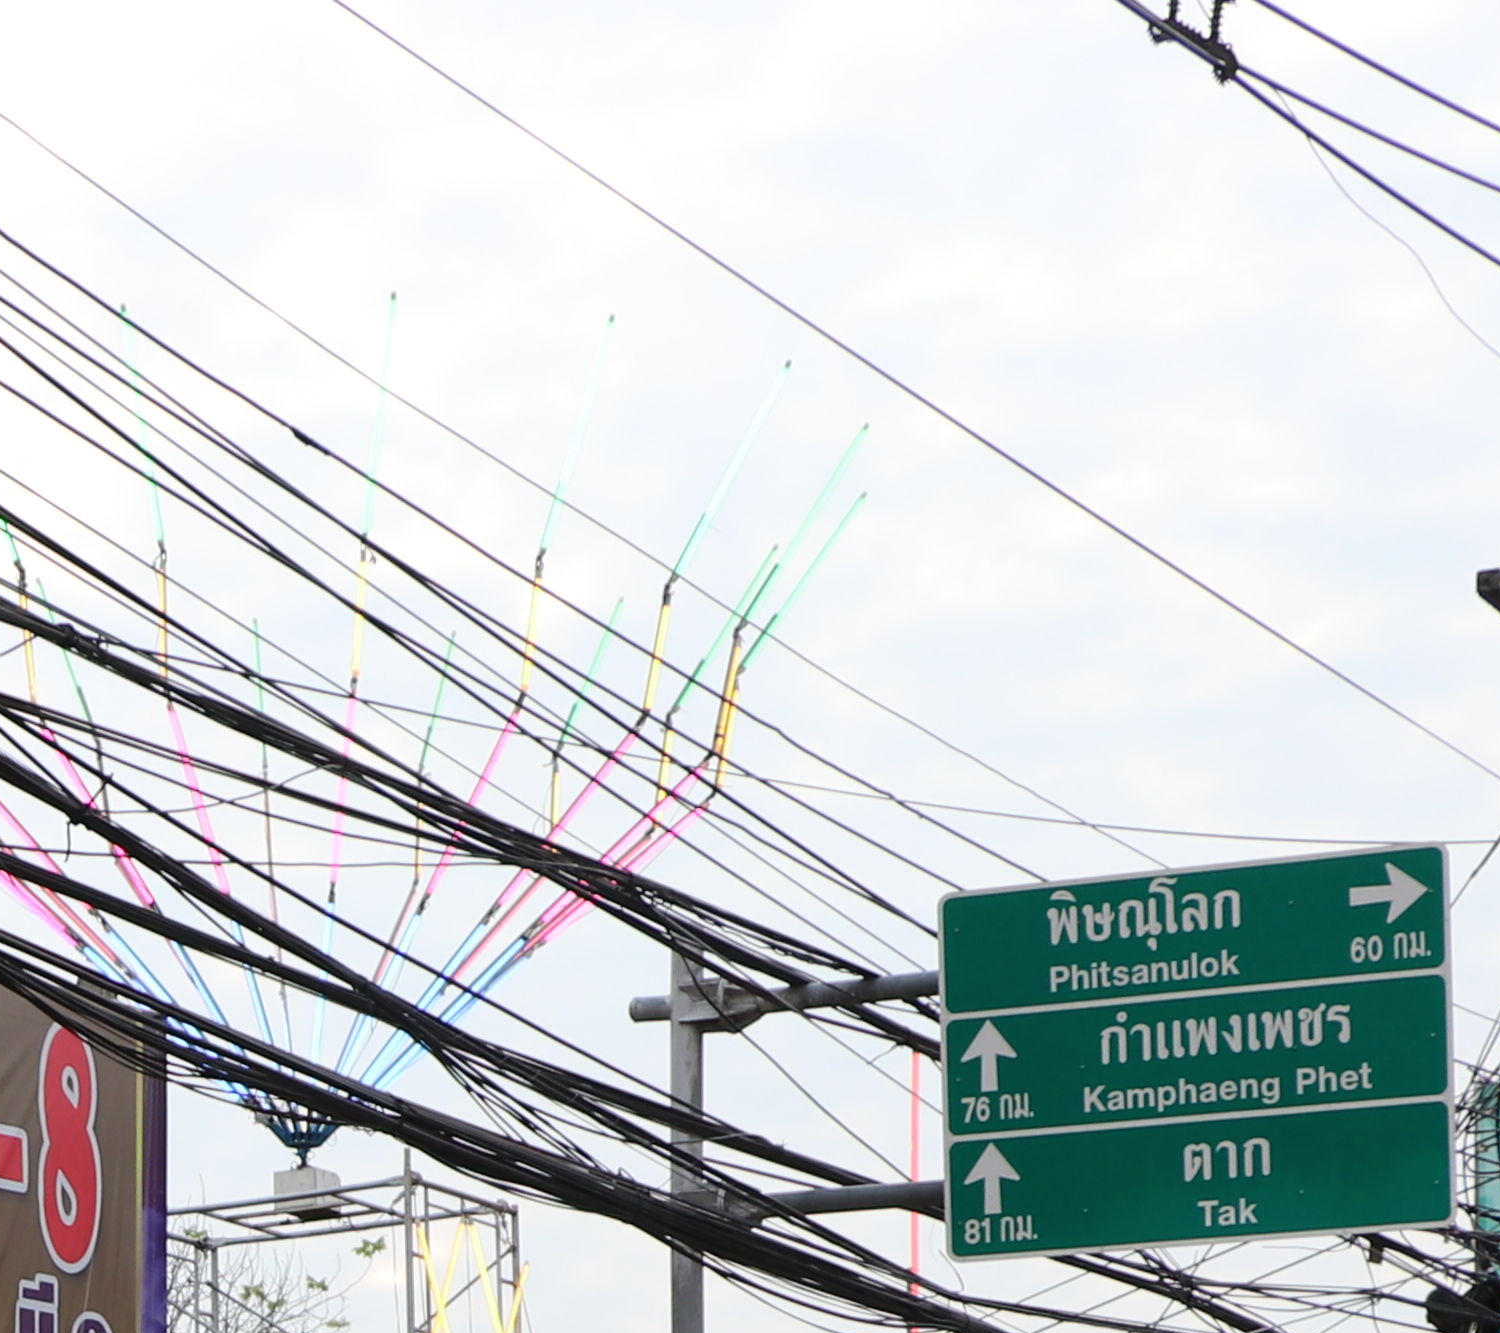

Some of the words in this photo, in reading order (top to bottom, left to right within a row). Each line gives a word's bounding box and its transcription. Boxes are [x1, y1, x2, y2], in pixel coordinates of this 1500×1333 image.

[1046, 874, 1242, 950] พิษณุโลก
[1349, 934, 1384, 963] 60
[1393, 930, 1433, 961] กม.
[1049, 949, 1240, 993] Phitsanulok
[1099, 1002, 1353, 1066] กำแพงเพชร
[961, 1096, 991, 1123] 76
[999, 1092, 1035, 1120] กม.
[1082, 1073, 1281, 1115] Kamphaeng
[1295, 1061, 1374, 1096] Phet
[1182, 1136, 1273, 1183] ตาก
[963, 1217, 993, 1246] 81
[1000, 1213, 1039, 1242] กม.
[1197, 1198, 1259, 1228] Tak
